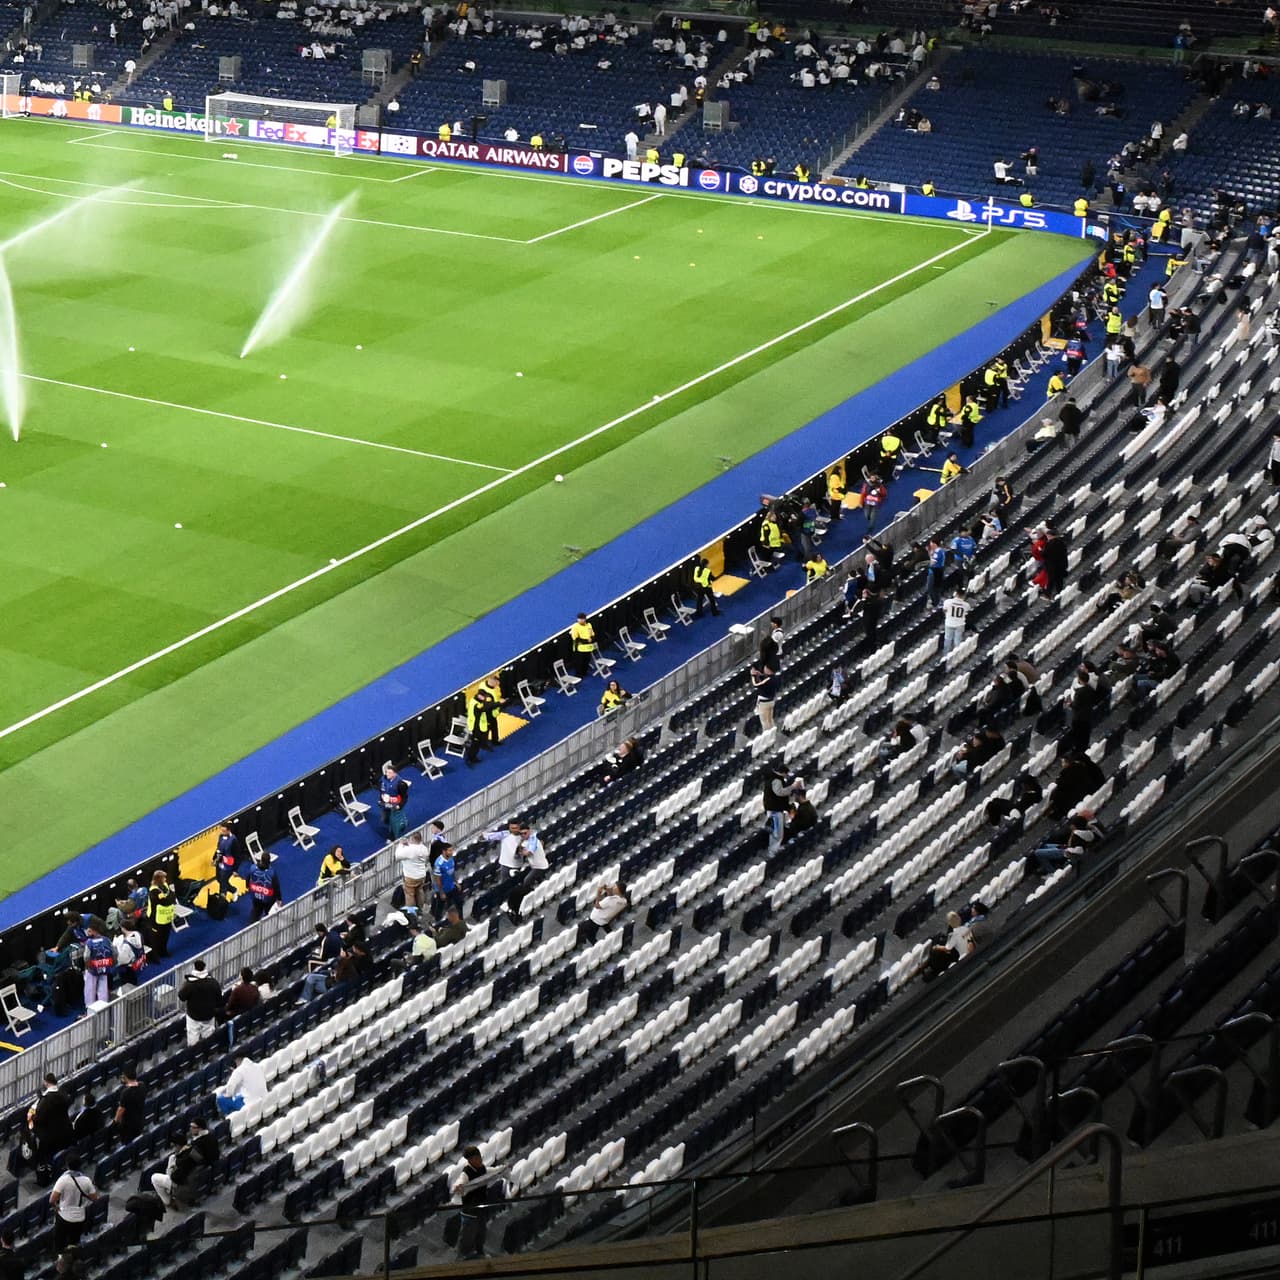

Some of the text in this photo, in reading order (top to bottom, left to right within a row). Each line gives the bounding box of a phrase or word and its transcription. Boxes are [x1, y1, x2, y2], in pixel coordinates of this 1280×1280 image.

[130, 109, 222, 134] Heineken
[255, 120, 307, 142] FedEx
[422, 140, 560, 169] QATAR AIRWAYS
[603, 157, 689, 187] PEPSI
[764, 178, 890, 209] crypto.com
[982, 206, 1046, 228] PS5
[951, 605, 964, 618] 10
[1152, 1235, 1183, 1257] 411
